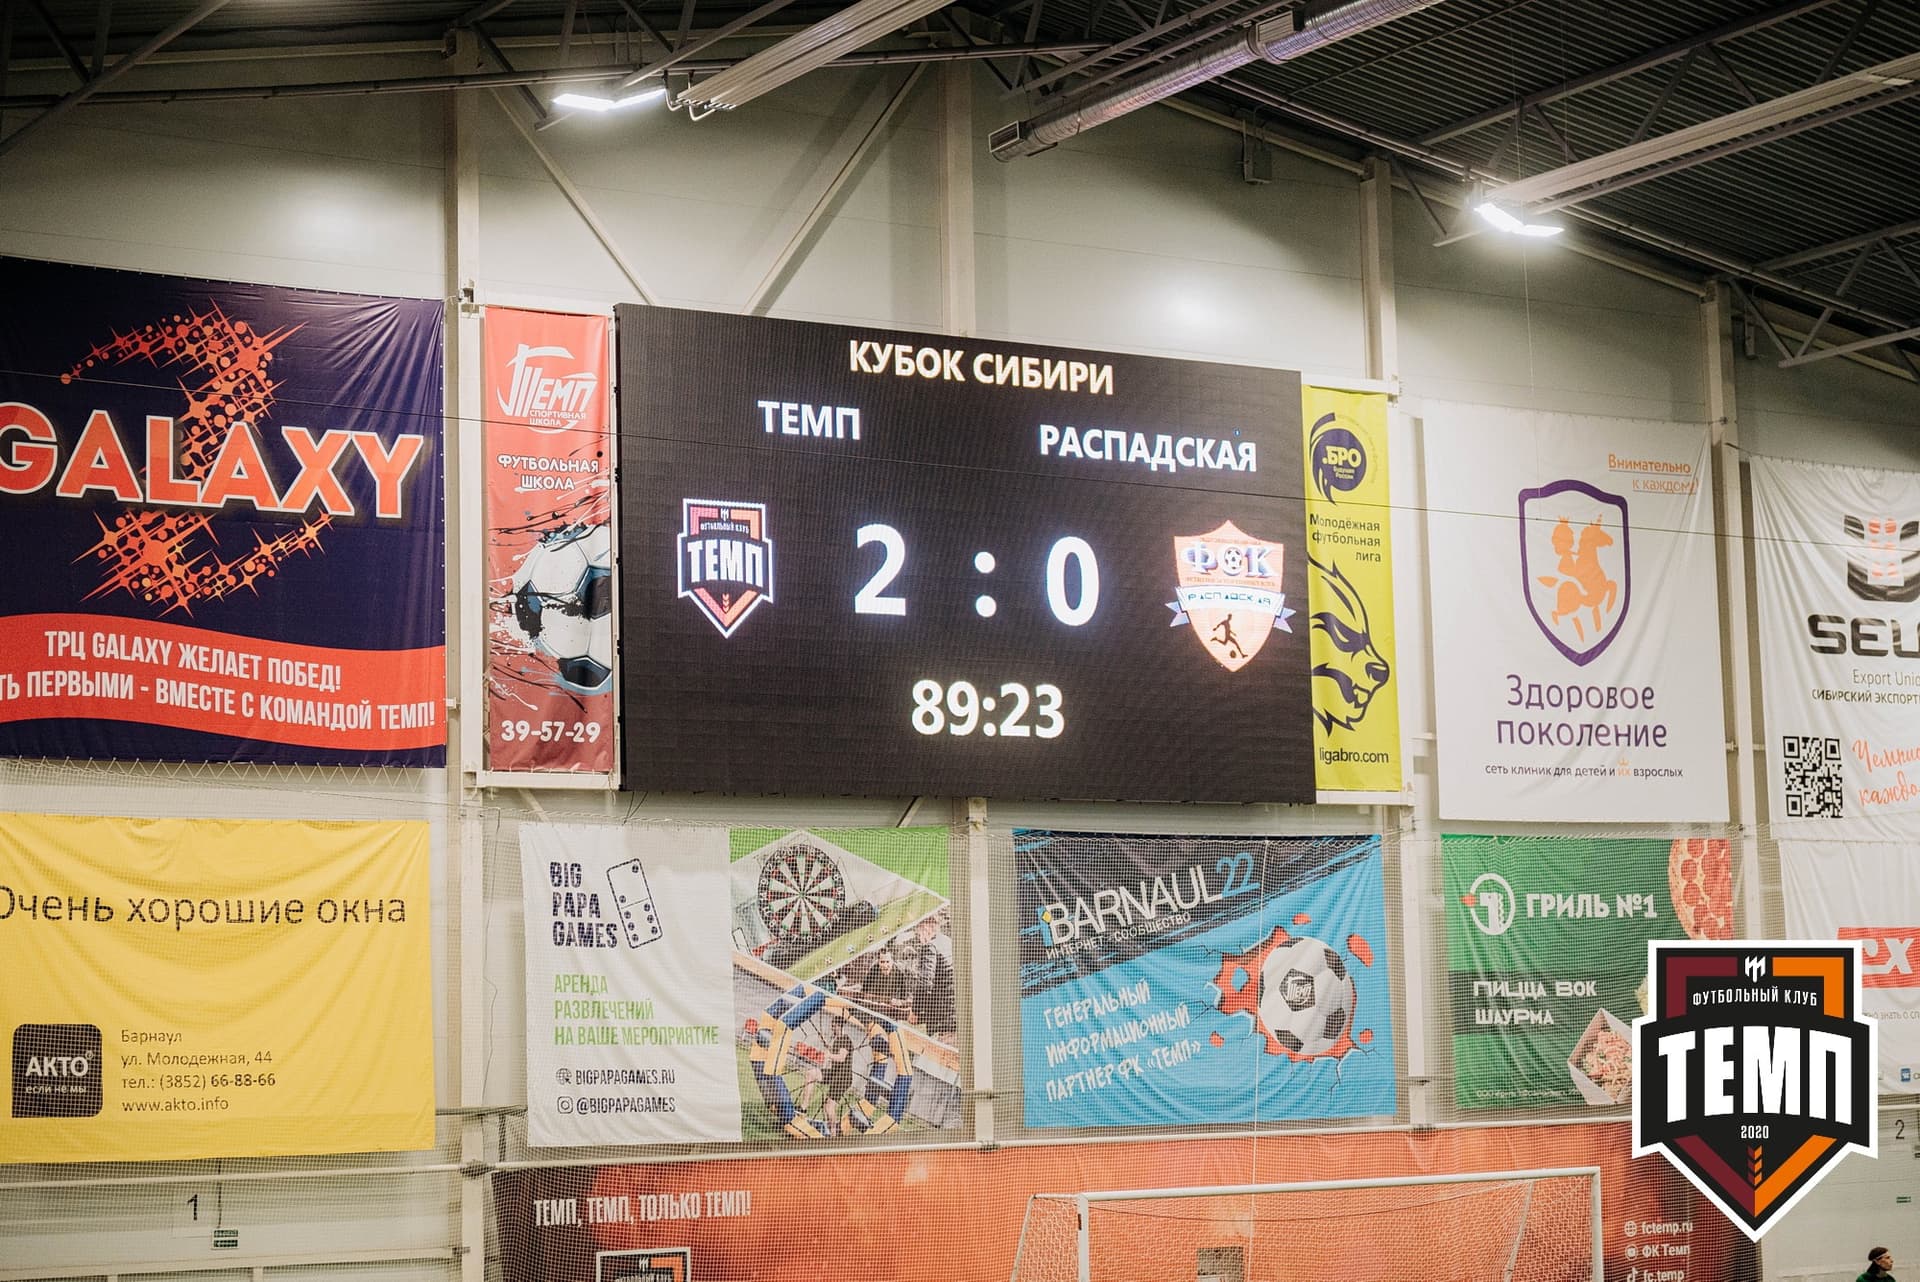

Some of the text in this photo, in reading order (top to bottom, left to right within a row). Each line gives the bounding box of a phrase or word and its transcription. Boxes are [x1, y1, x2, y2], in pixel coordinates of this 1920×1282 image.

[849, 340, 1114, 396] КУБОК СИБИРИ
[497, 344, 598, 417] ТЕМП
[529, 409, 587, 420] СПОРТИВНАЯ
[529, 418, 563, 427] ШКОЛА
[757, 400, 862, 440] ТЕМП
[1039, 424, 1258, 473] РАСПАДСКАЯ
[0, 402, 424, 518] GALAXY
[497, 454, 600, 473] ФУТБОЛЬНАЯ
[1608, 454, 1692, 473] Внимательно
[521, 475, 576, 490] ШКОЛА
[1632, 480, 1640, 489] к
[1310, 514, 1381, 532] Молодёжная
[1312, 530, 1382, 548] футбольная
[687, 539, 764, 588] ТЕМП
[1355, 550, 1382, 563] лига
[854, 523, 907, 616] 2
[1046, 536, 1100, 626] 0
[1808, 614, 1920, 658] SEL
[45, 631, 341, 692] ТРЦ GALAXY ЖЕЛАЕТ ПОБЕД!
[1853, 669, 1891, 687] Export
[27, 670, 134, 701] ПЕРВЫМИ
[156, 678, 236, 714] ВМЕСТЕ
[242, 692, 254, 717] С
[260, 697, 372, 731] КОМАНДОЙ
[378, 701, 435, 730] ТЕМП!
[1507, 674, 1655, 713] Здоровое
[1811, 688, 1920, 705] СИБИРСКИЙ ЭКСПОРТ
[911, 679, 1065, 740] 89:23
[501, 720, 601, 744] 39-57-29
[1497, 721, 1668, 749] поколение
[1319, 747, 1389, 767] ligabro.com
[1485, 764, 1683, 779] сеть клиник для детей и их взрослых
[549, 861, 582, 888] BIG
[127, 897, 304, 931] хорошие
[317, 897, 406, 923] окна
[551, 892, 601, 919] PAPA
[1526, 893, 1658, 918] ГРИЛЬ №1
[552, 922, 618, 949] GAMES
[1045, 935, 1104, 960] ИНТЕРНЕТ
[1114, 912, 1192, 942] СООБЩЕСТВО
[554, 974, 608, 996] АРЕНДА
[1473, 980, 1597, 1000] ПИЦЦА ВОК
[554, 998, 654, 1020] РАЗВЛЕЧЕНИЙ
[1043, 978, 1152, 1030] ГЕНЕРАЛЬНЫЙ
[1475, 1009, 1554, 1025] ШАУРМА
[121, 1029, 183, 1045] Барнаул
[554, 1025, 719, 1047] НА ВАШЕ МЕРОПРИЯТИЕ
[1045, 1004, 1191, 1067] ИНФОРМАЦИОННЫЙ
[121, 1050, 273, 1069] ул. Молодежная, 44
[122, 1072, 276, 1091] тел.: (3852) 66-88-66
[576, 1069, 675, 1086] BIGPAPAGAMES.RU
[1046, 1040, 1202, 1102] ПАРТНЕР ФК «ТЕМП»
[25, 1084, 87, 1094] если не мы
[122, 1096, 229, 1112] www.akto.info
[576, 1096, 675, 1115] @BIGPAPAGAMES
[1895, 1119, 1905, 1140] 2
[187, 1194, 198, 1221] 1
[534, 1190, 751, 1228] ТЕМП, ТЕМП, ТОЛЬКО ТЕМП!
[1641, 1221, 1693, 1236] fctemp.ru
[1642, 1243, 1690, 1258] ФК Темп
